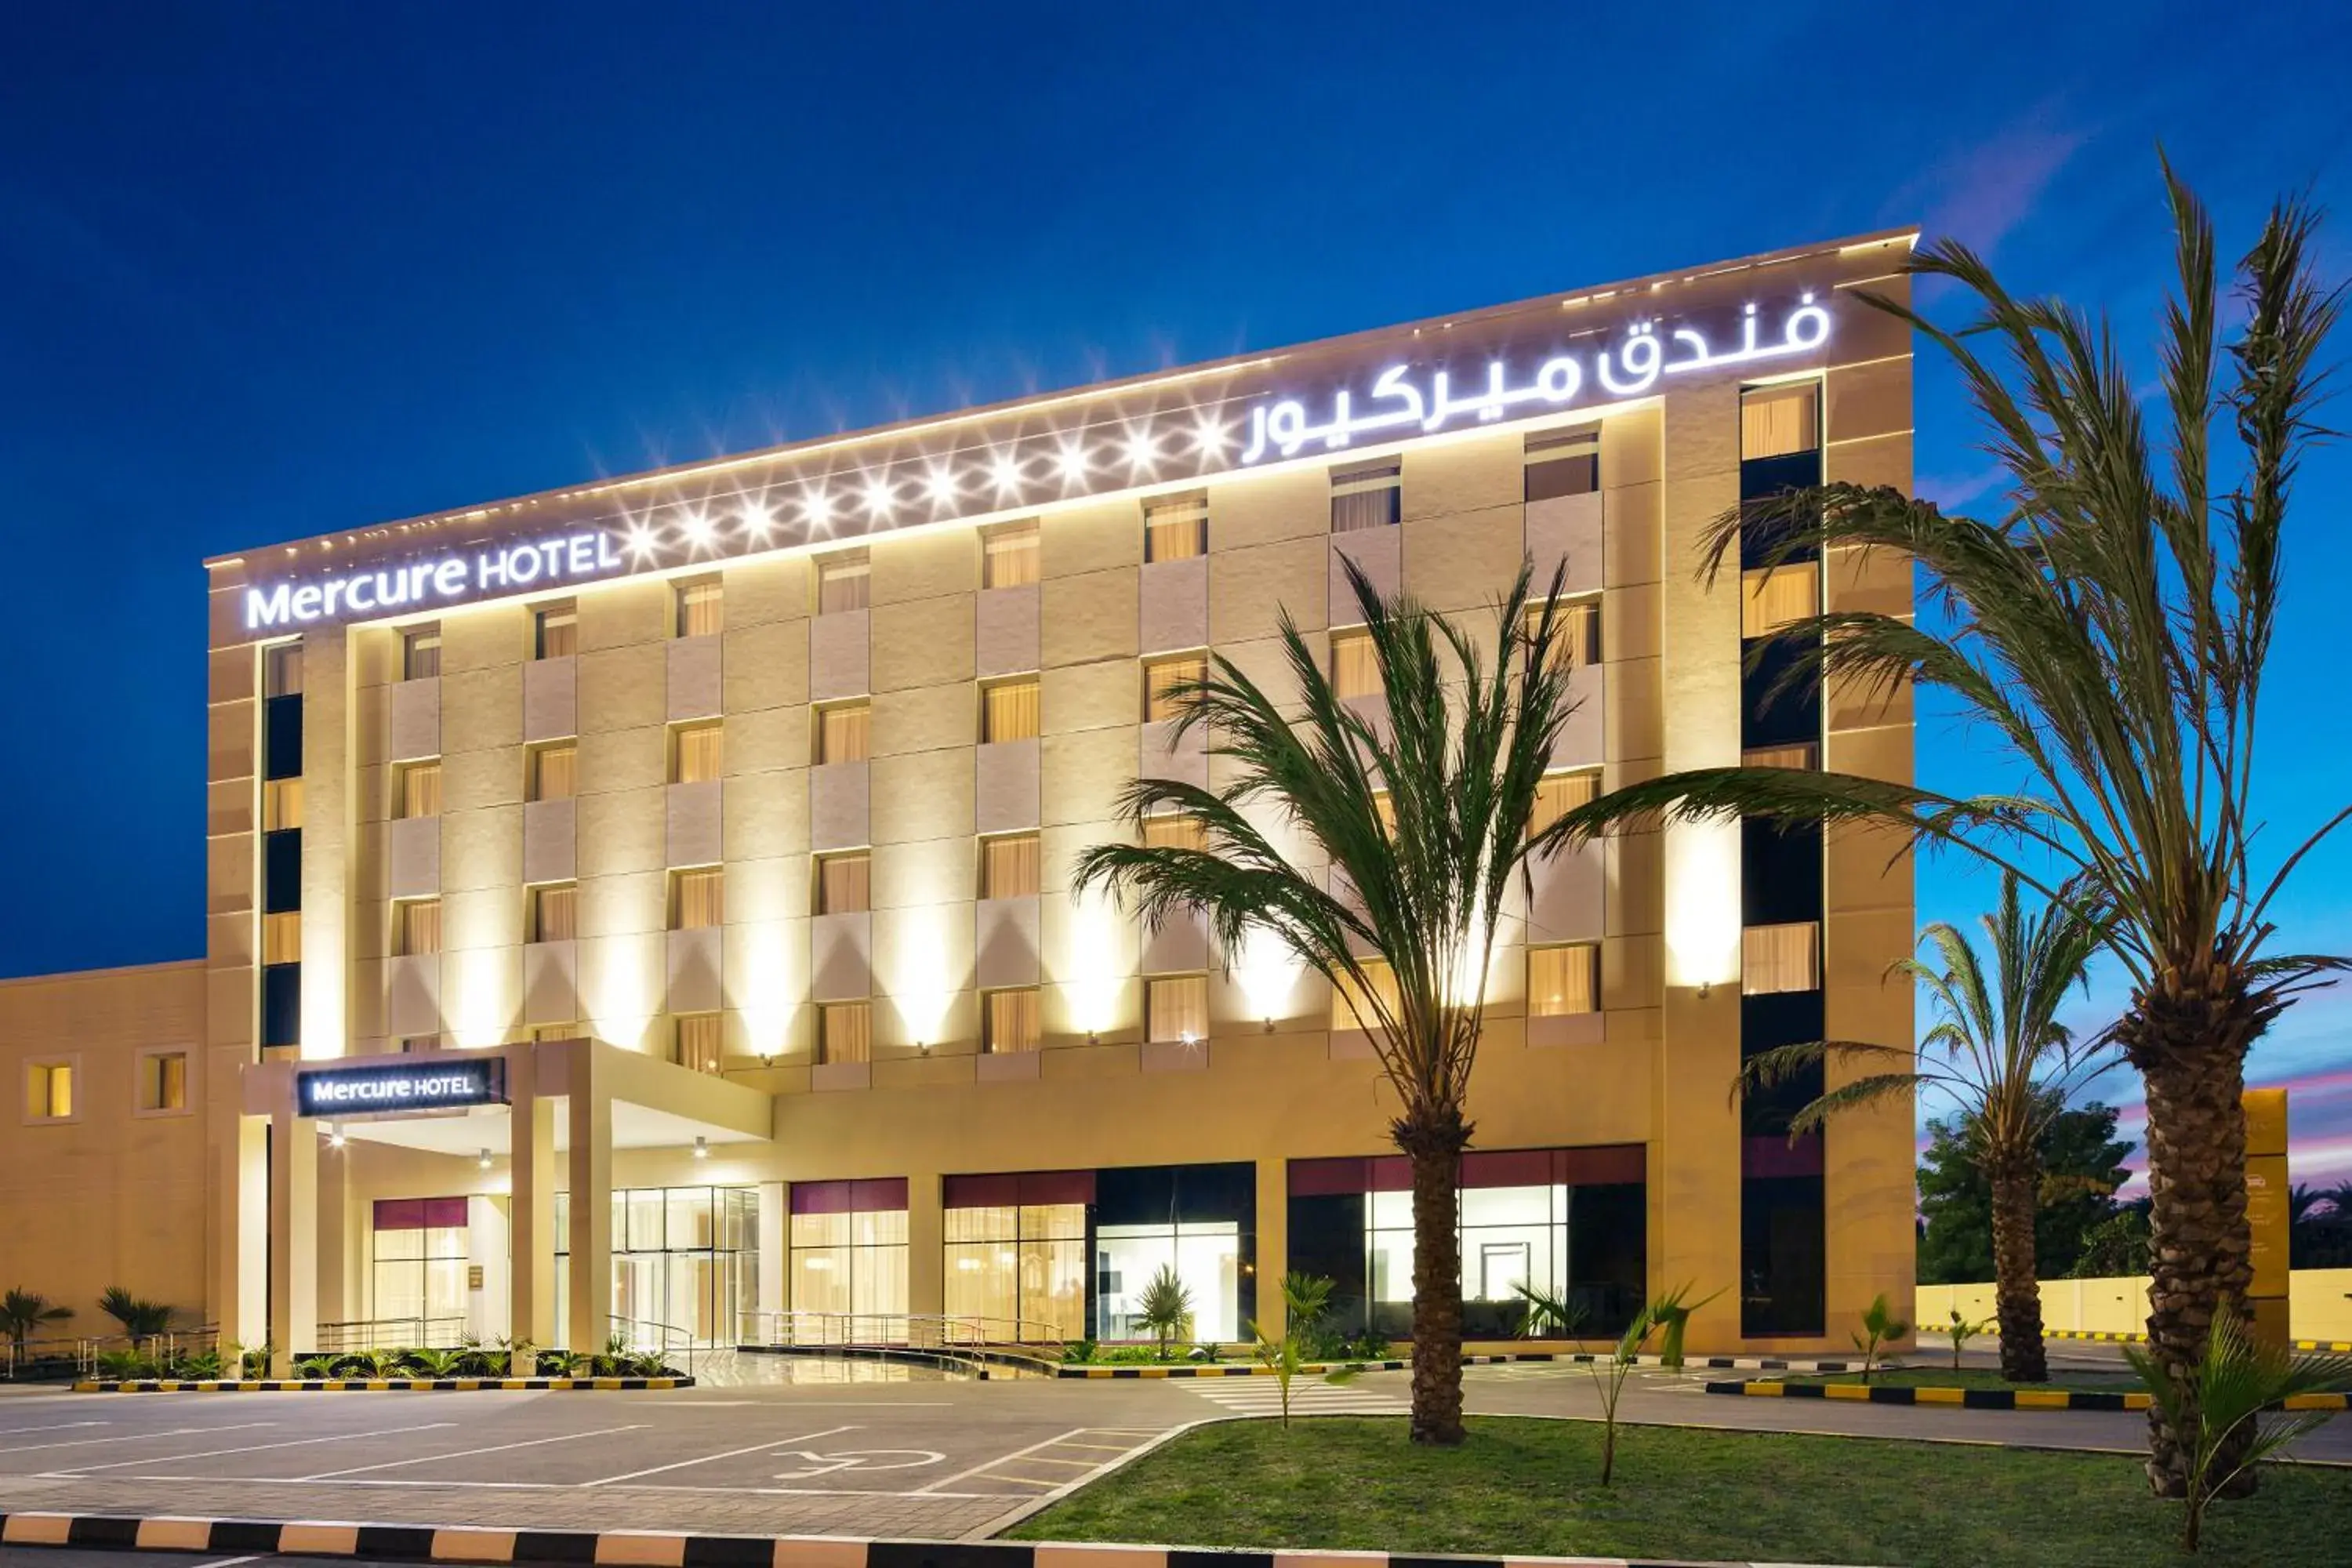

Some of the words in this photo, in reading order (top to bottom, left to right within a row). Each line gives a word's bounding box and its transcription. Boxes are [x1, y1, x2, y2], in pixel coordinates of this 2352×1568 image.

[1598, 293, 1831, 394] فندق
[1242, 358, 1581, 463] ميركيور
[246, 558, 467, 629] Mercure
[479, 532, 621, 589] HOTEL
[314, 1080, 409, 1101] Mercure
[415, 1076, 474, 1095] HOTEL
